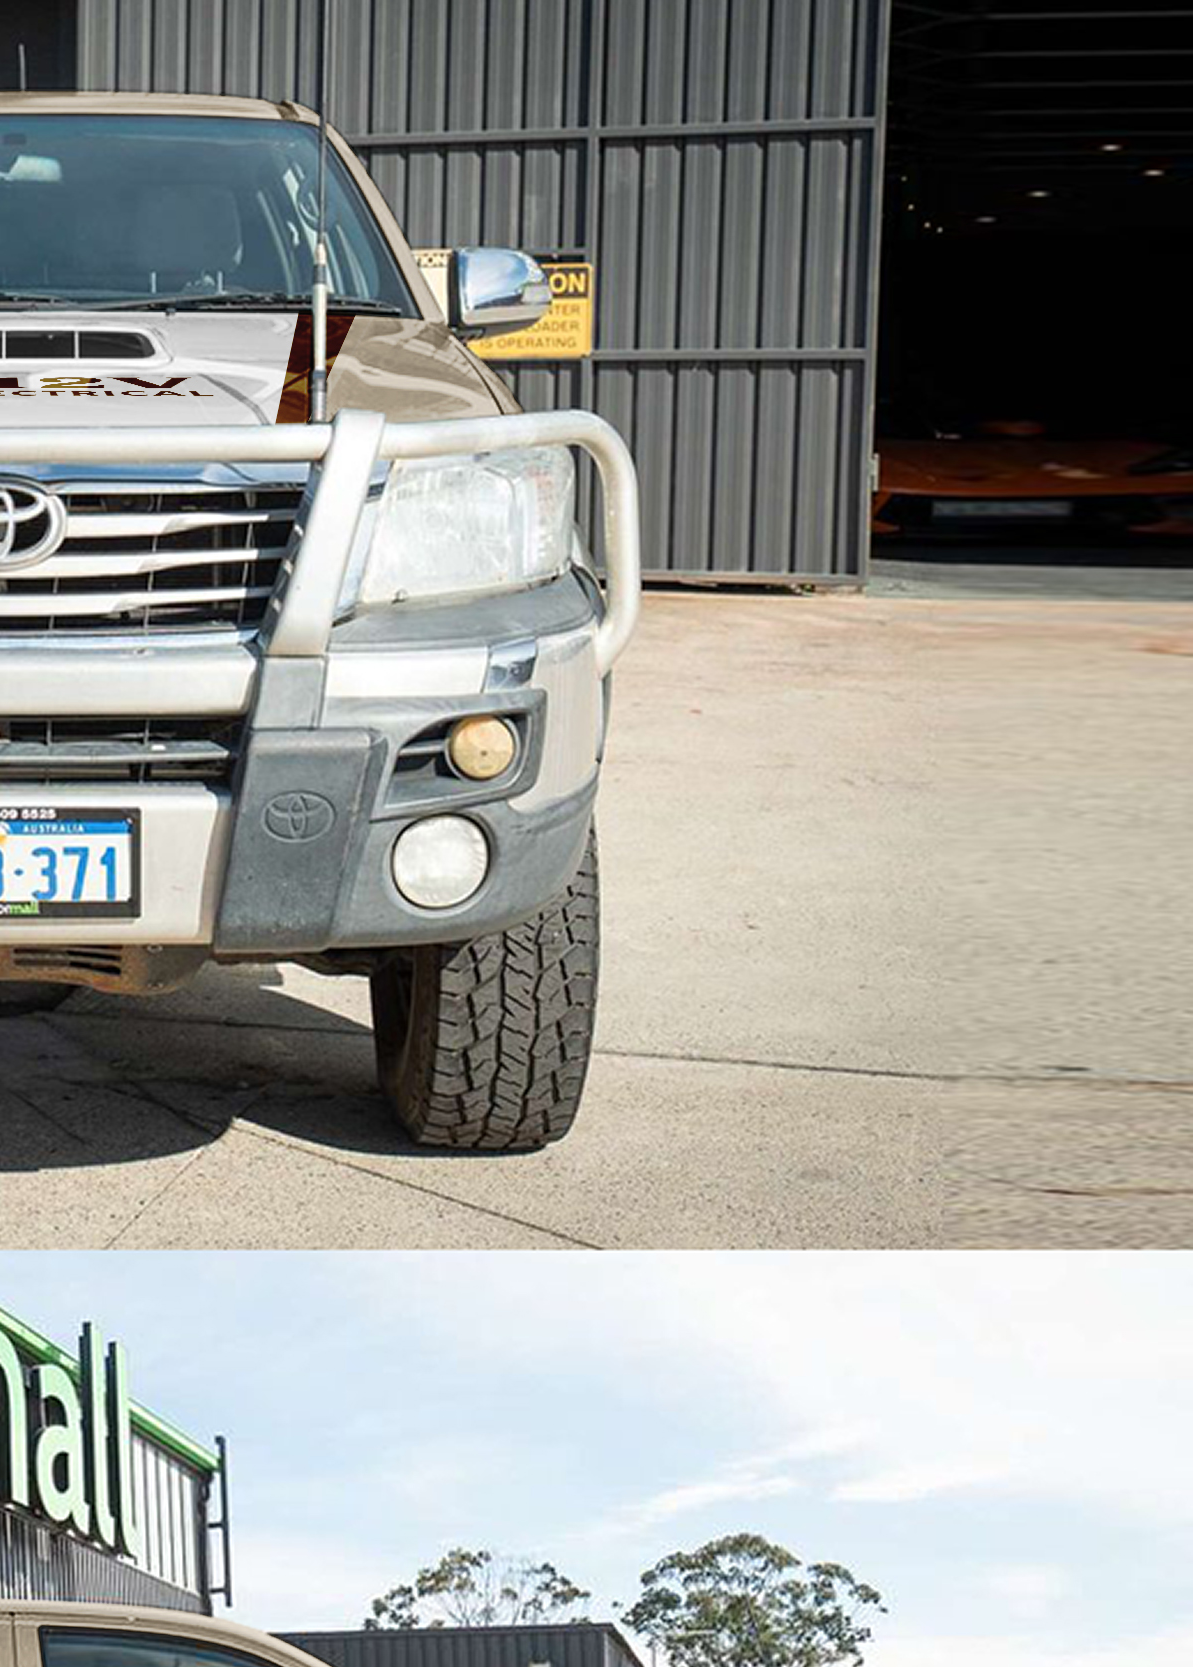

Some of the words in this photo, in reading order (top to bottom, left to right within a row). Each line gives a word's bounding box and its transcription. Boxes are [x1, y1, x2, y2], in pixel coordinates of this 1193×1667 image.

[549, 272, 586, 294] ON
[524, 321, 580, 333] OADER
[496, 337, 578, 349] OPERATING
[22, 825, 85, 834] AUSTRALIA
